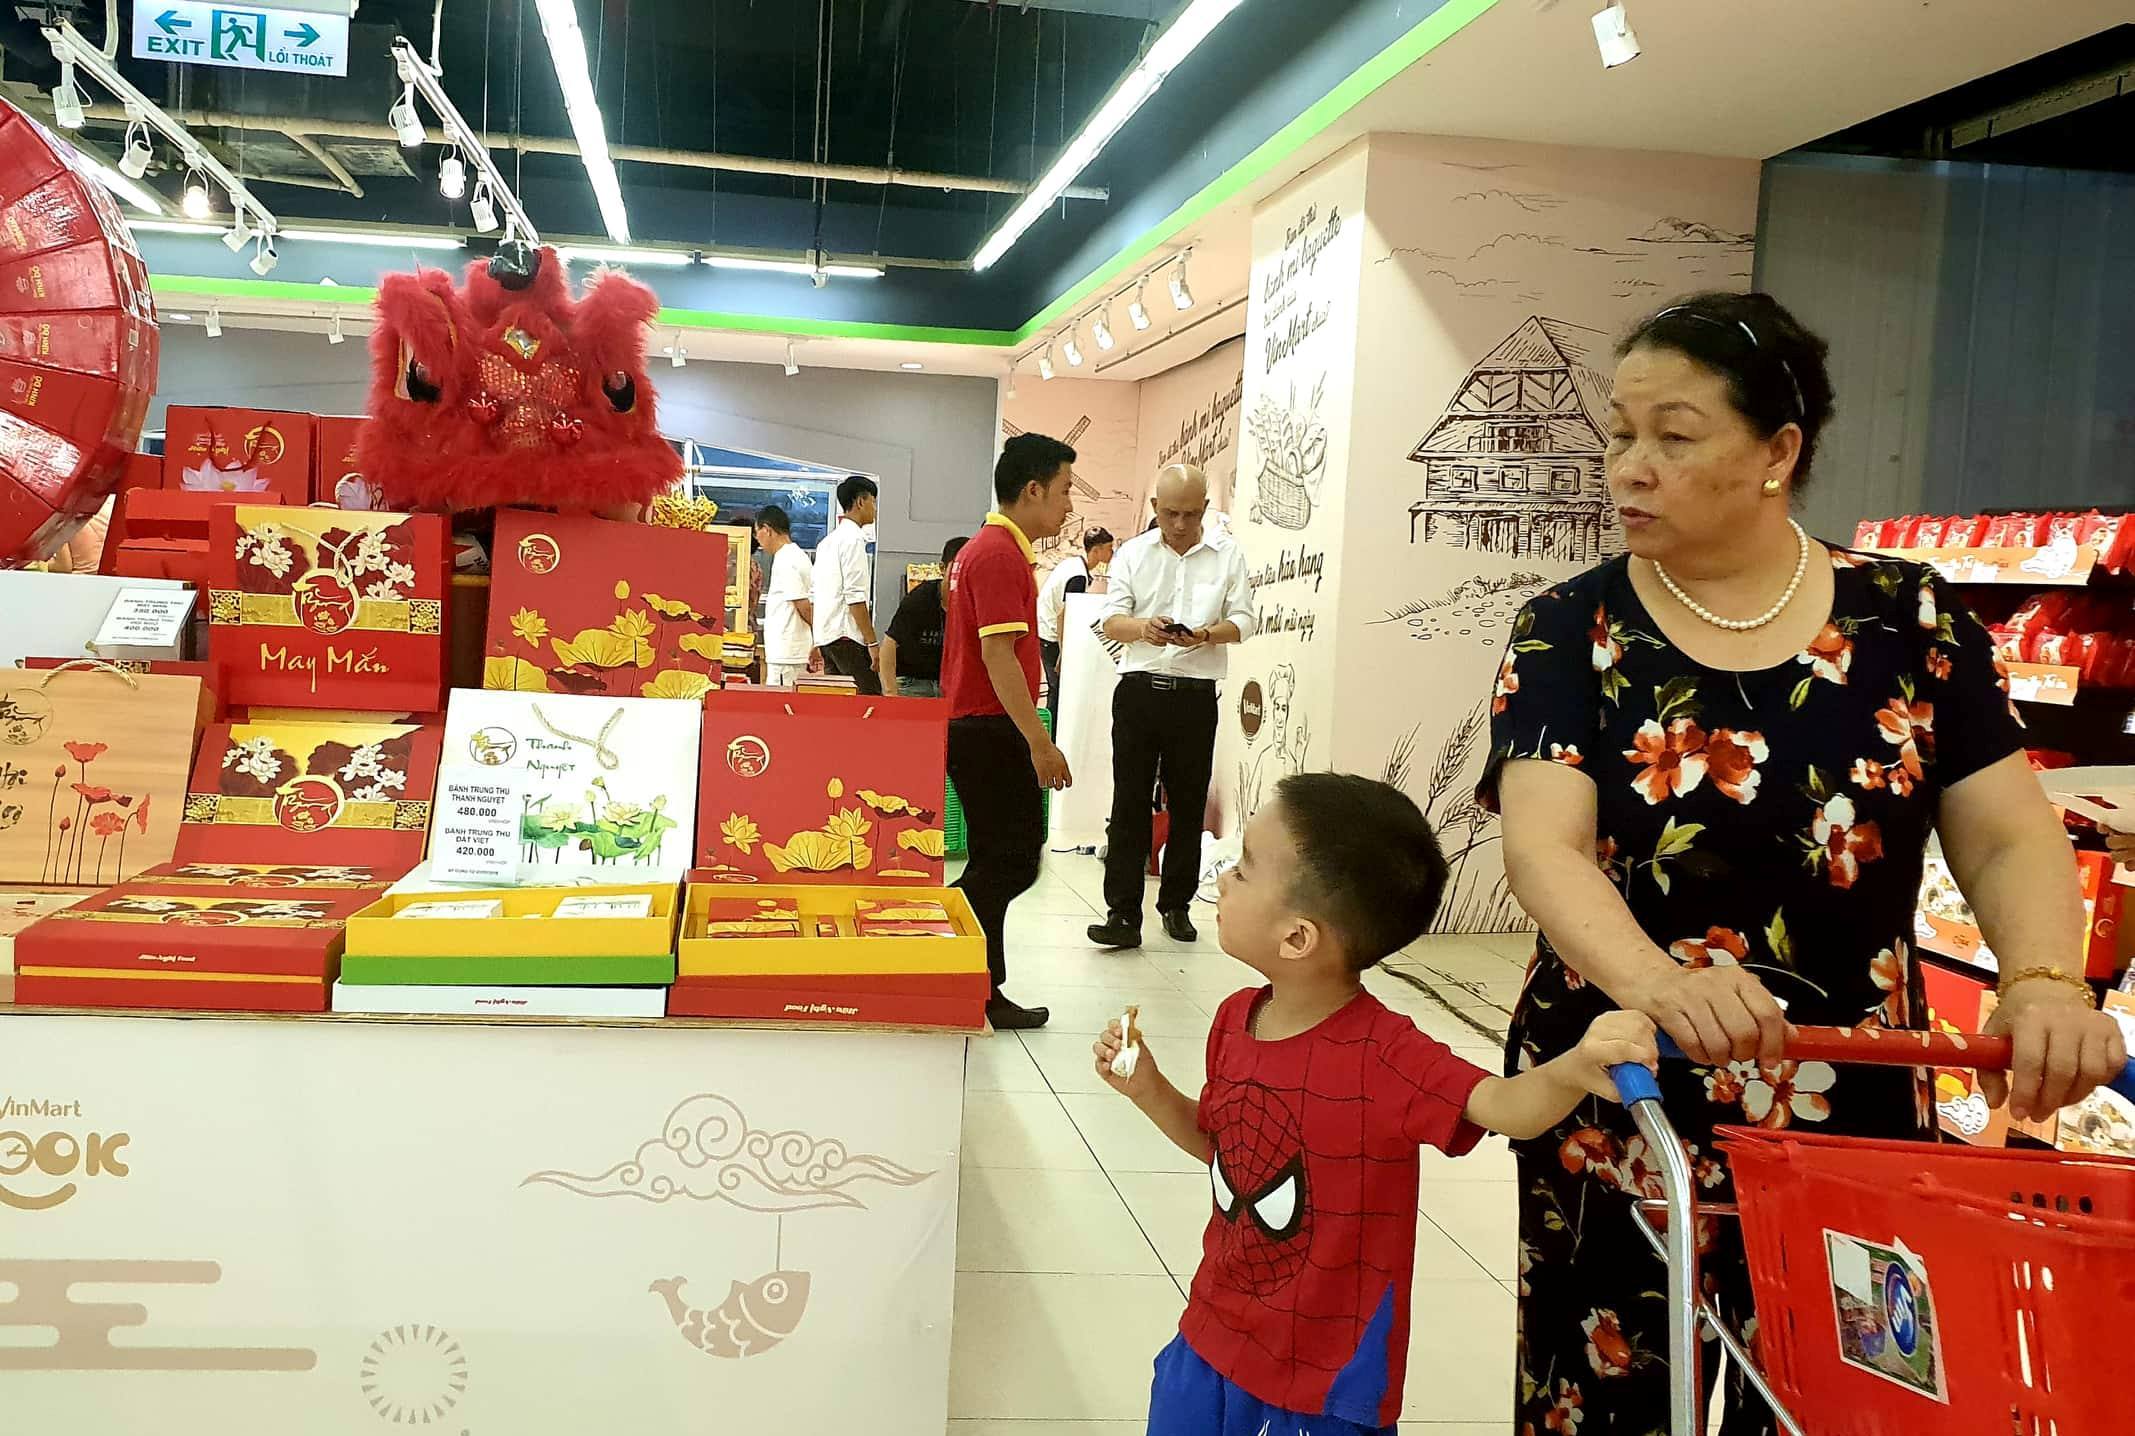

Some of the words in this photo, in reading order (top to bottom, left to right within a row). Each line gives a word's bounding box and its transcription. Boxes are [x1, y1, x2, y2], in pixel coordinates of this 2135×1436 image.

[147, 36, 205, 56] EXIT
[294, 51, 334, 67] THOÁT
[1301, 205, 1342, 276] baguette
[260, 642, 318, 694] May
[326, 646, 391, 673] Mắn
[448, 784, 469, 793] BÁNH
[470, 786, 494, 794] TRUNG
[496, 787, 511, 795] THU
[452, 794, 476, 802] THANH
[457, 807, 497, 818] 480.000
[468, 829, 494, 837] TRUNG
[496, 830, 511, 838] THU
[456, 846, 495, 857] 420.000
